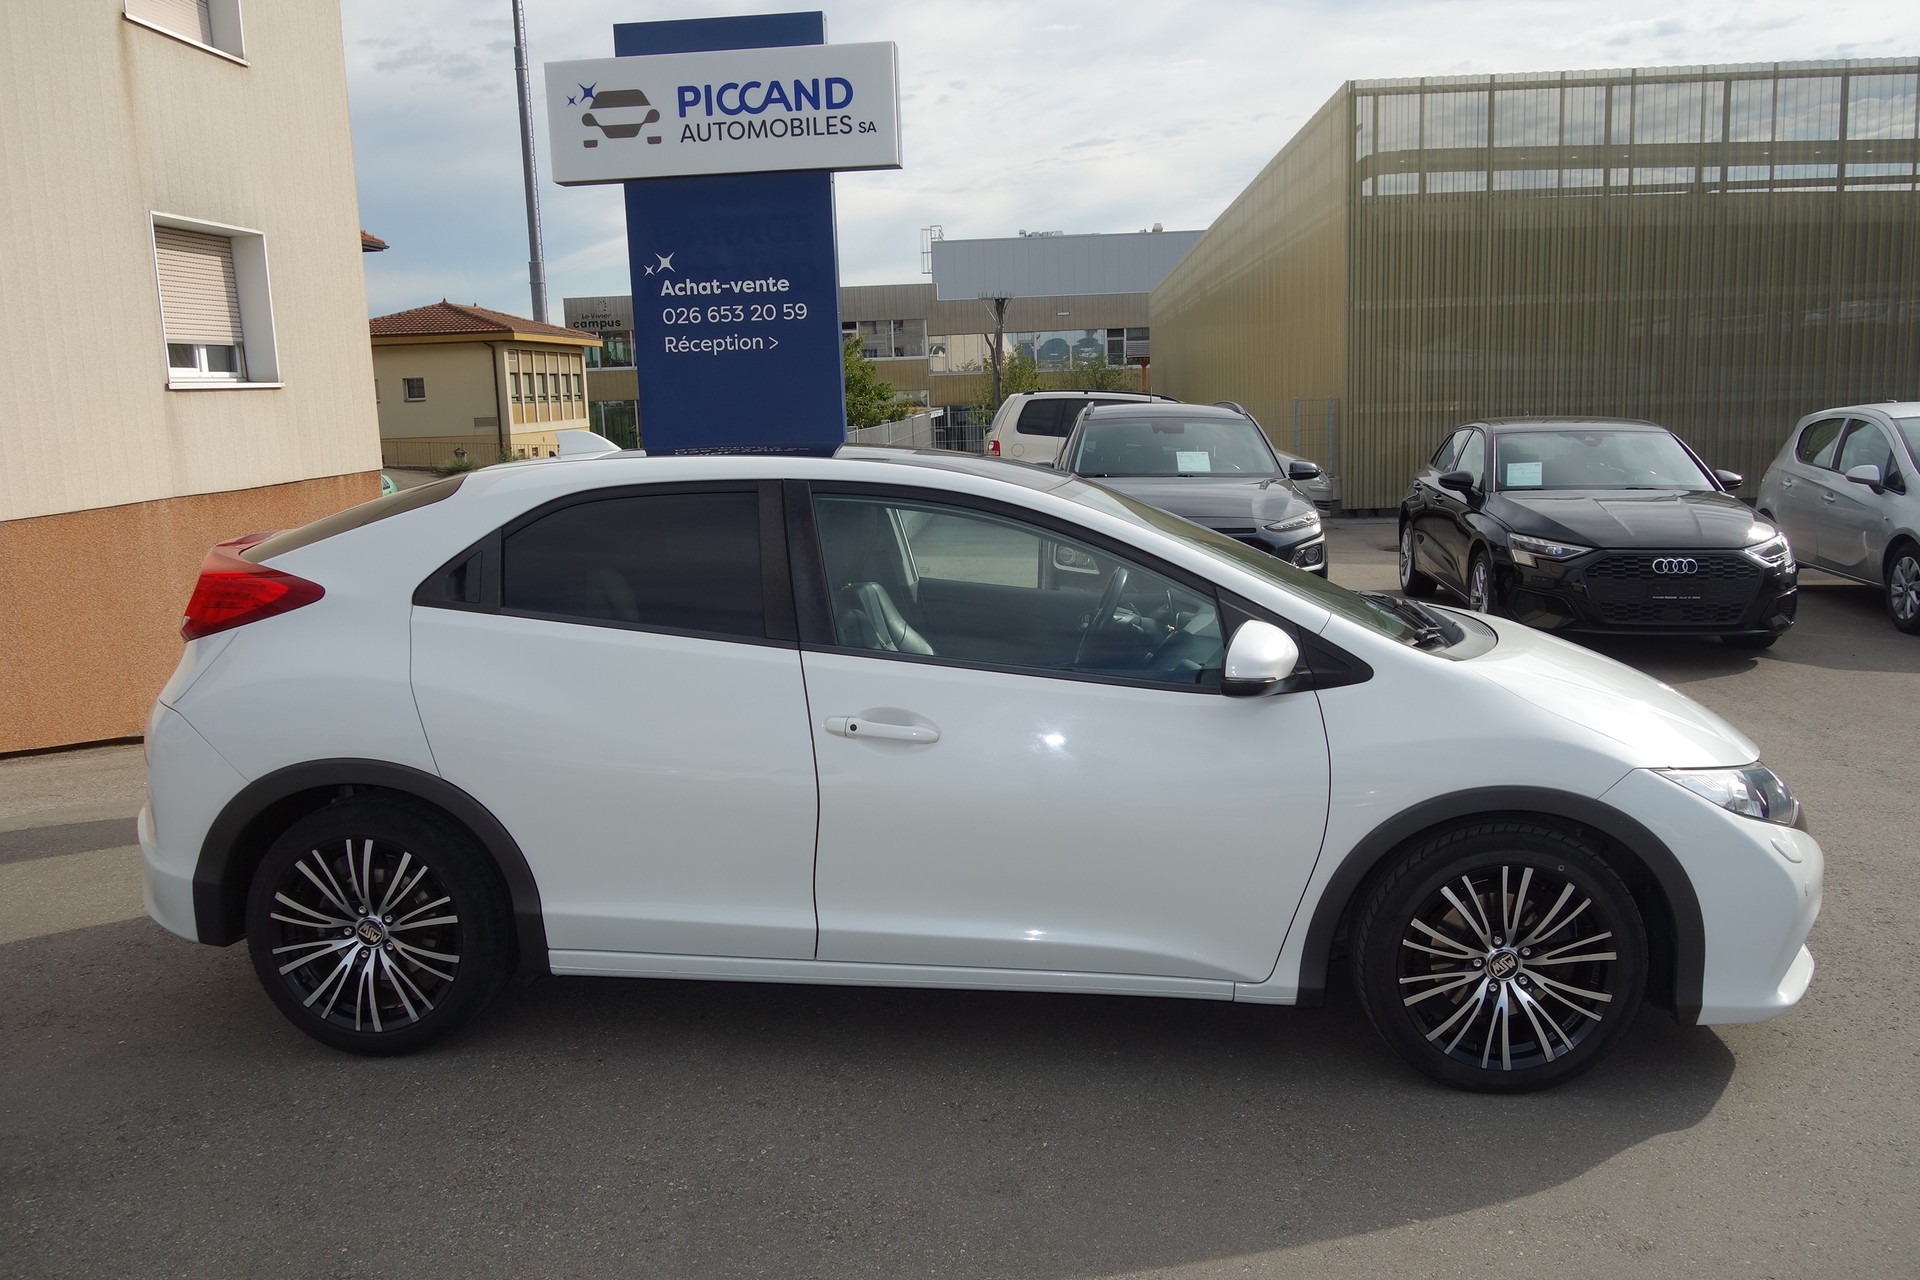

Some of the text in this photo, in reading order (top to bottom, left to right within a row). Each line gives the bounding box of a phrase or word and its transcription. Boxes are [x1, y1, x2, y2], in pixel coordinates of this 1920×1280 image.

[677, 77, 853, 118] PICCAND
[680, 115, 877, 143] AUTOMOBILES SA
[660, 277, 790, 297] Achat-vente
[574, 319, 621, 330] campus
[662, 303, 807, 325] 026 653 20 59
[665, 333, 764, 355] Réception
